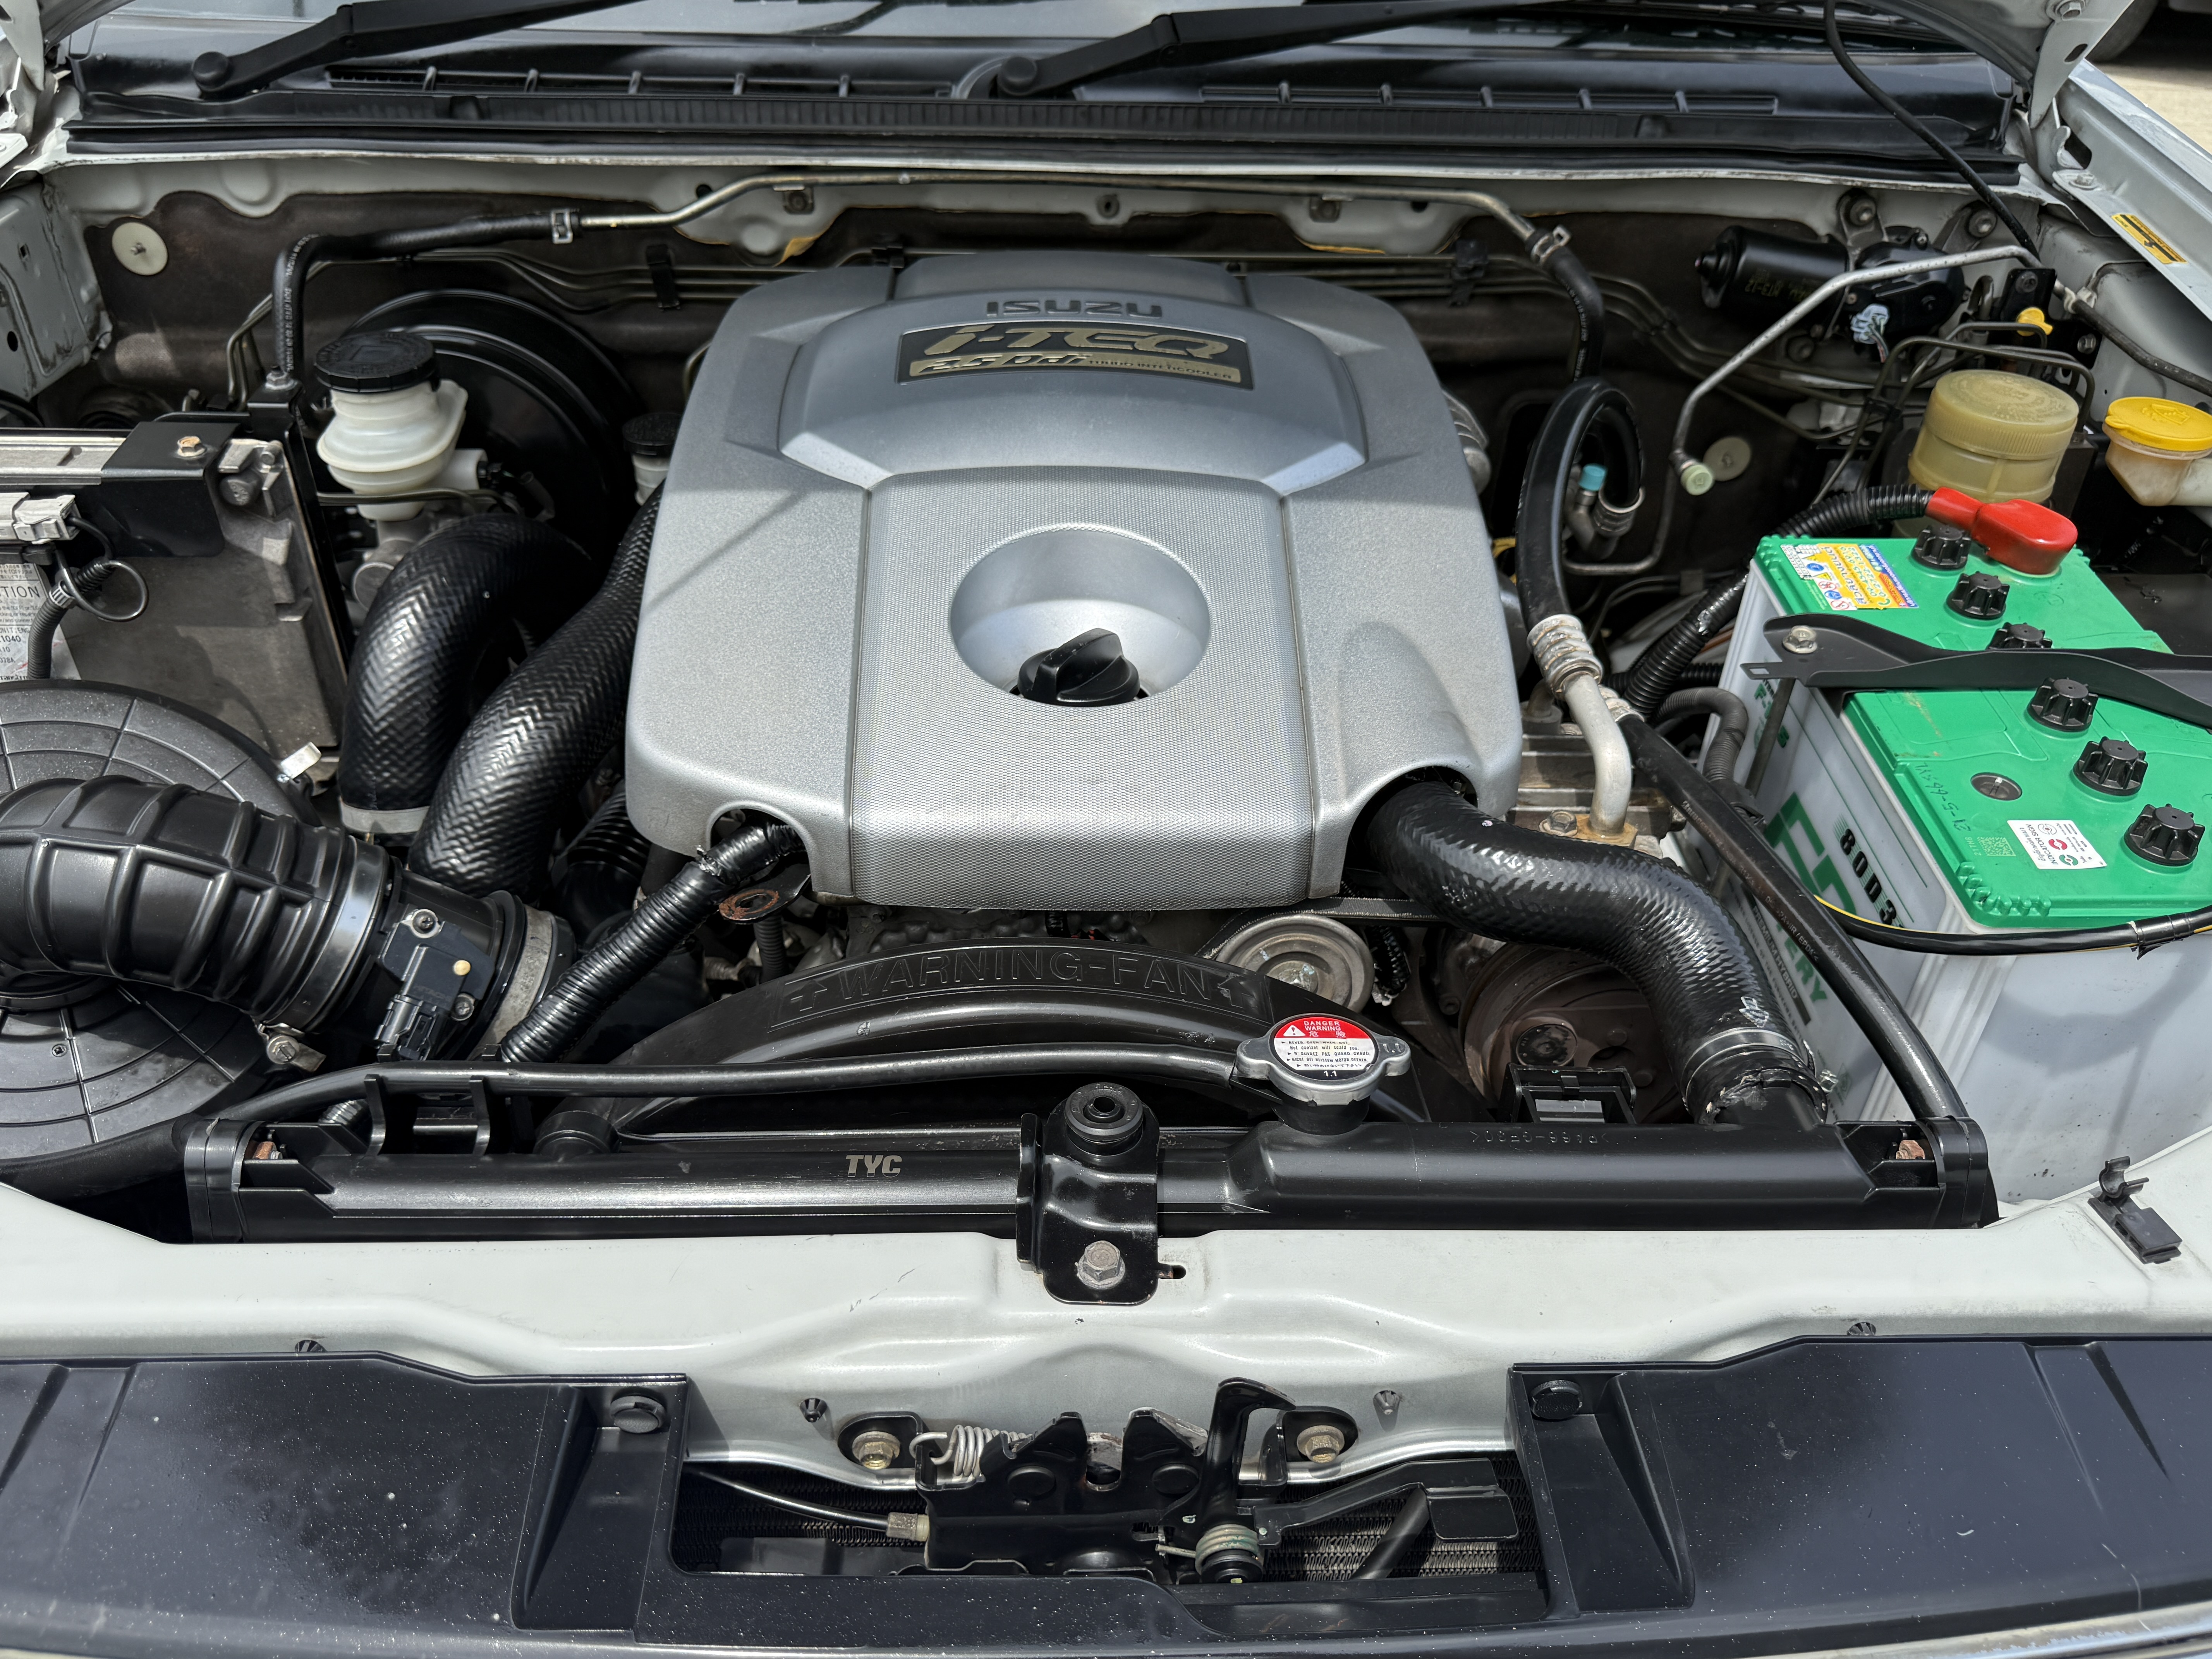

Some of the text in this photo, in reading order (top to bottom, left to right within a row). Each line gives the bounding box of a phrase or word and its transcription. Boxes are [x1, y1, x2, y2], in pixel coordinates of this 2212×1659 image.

[986, 300, 1162, 318] ISUZU
[924, 325, 1229, 359] i-TEQ
[1138, 363, 1231, 379] INTERCOOLER
[2026, 824, 2059, 865] INDICATOR SIGN
[1840, 828, 1905, 928] 80D3
[1753, 905, 1778, 957] PREMIUM
[1776, 957, 1797, 999] HYBRID
[846, 1155, 902, 1178] TYC
